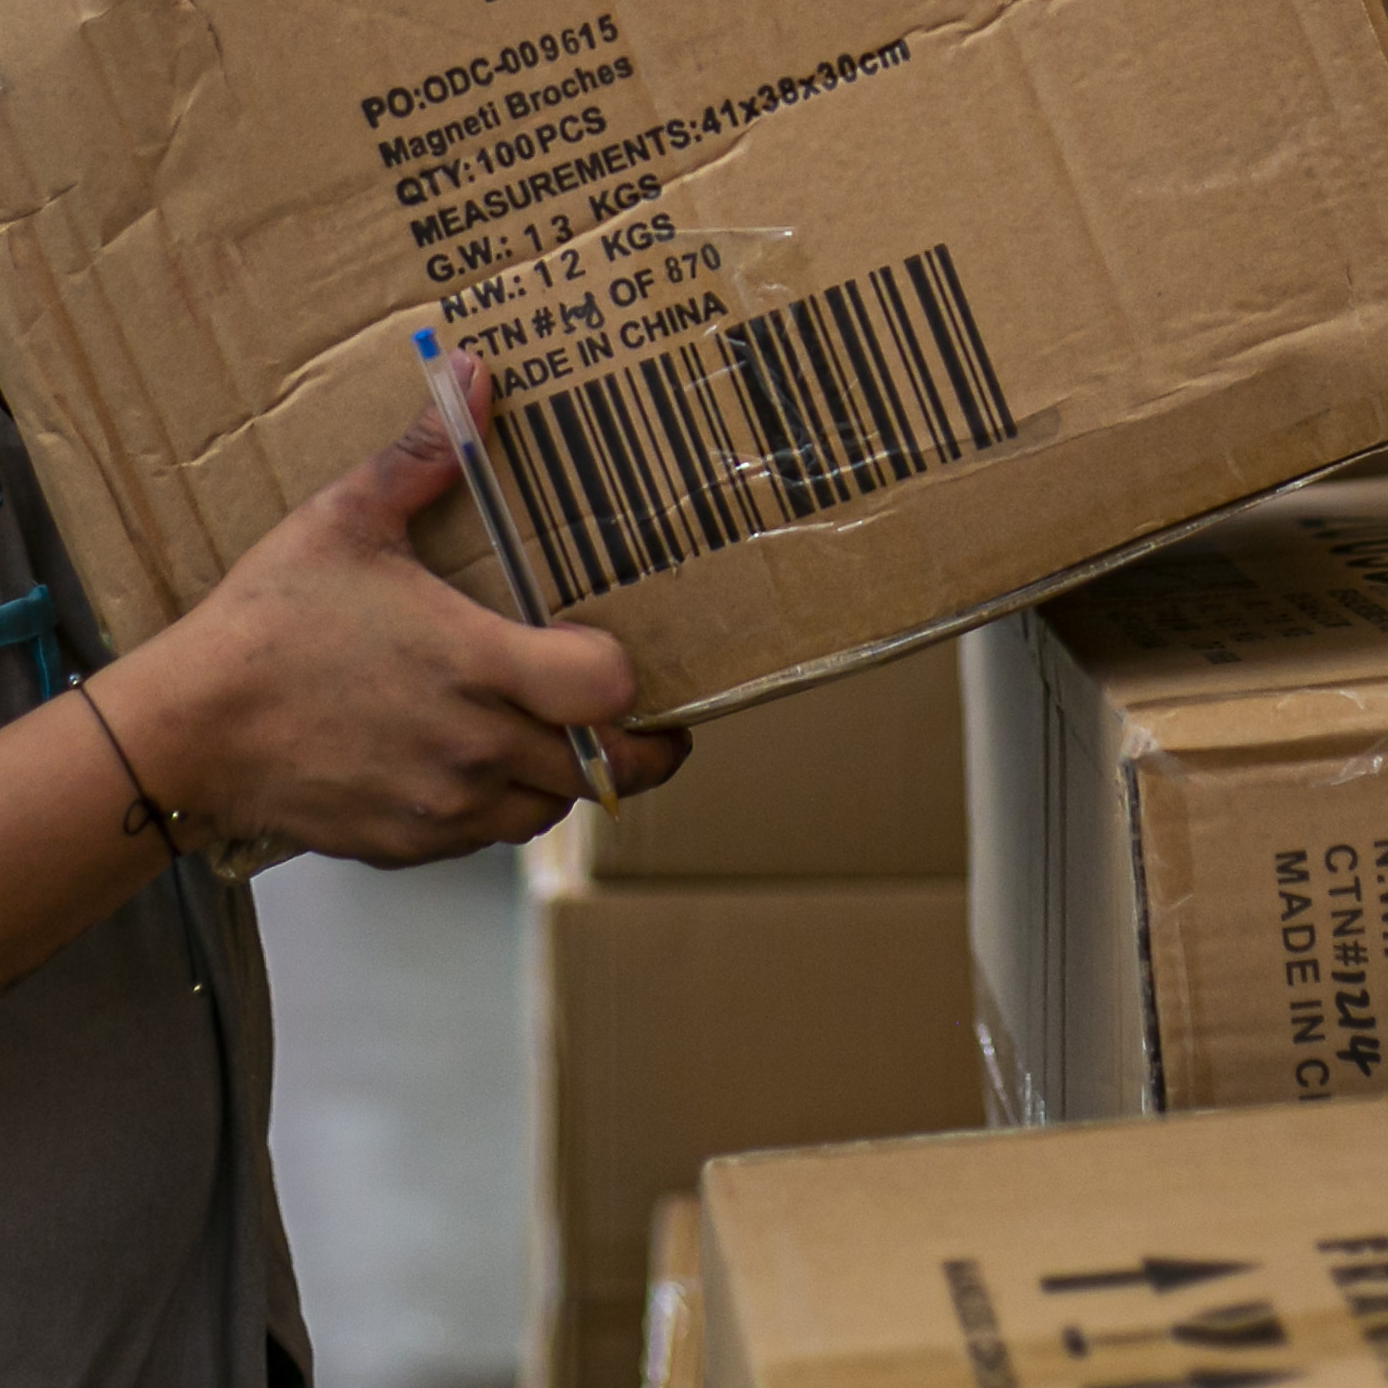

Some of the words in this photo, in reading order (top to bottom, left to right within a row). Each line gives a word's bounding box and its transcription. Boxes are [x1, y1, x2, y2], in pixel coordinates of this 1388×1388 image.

[361, 14, 619, 128] PO:ODC-009615
[378, 102, 501, 169] Magneti
[509, 55, 635, 121] Broches
[426, 234, 513, 283] G.W.:
[589, 173, 663, 222] KGS
[440, 275, 526, 324] N.W.:
[601, 212, 676, 262] KGS
[457, 317, 528, 358] CTN
[609, 269, 655, 308] OF
[665, 242, 722, 285] 870
[576, 331, 615, 368] IN
[619, 290, 729, 350] CHINA
[1274, 849, 1322, 987] MADE
[1290, 999, 1327, 1045] IN
